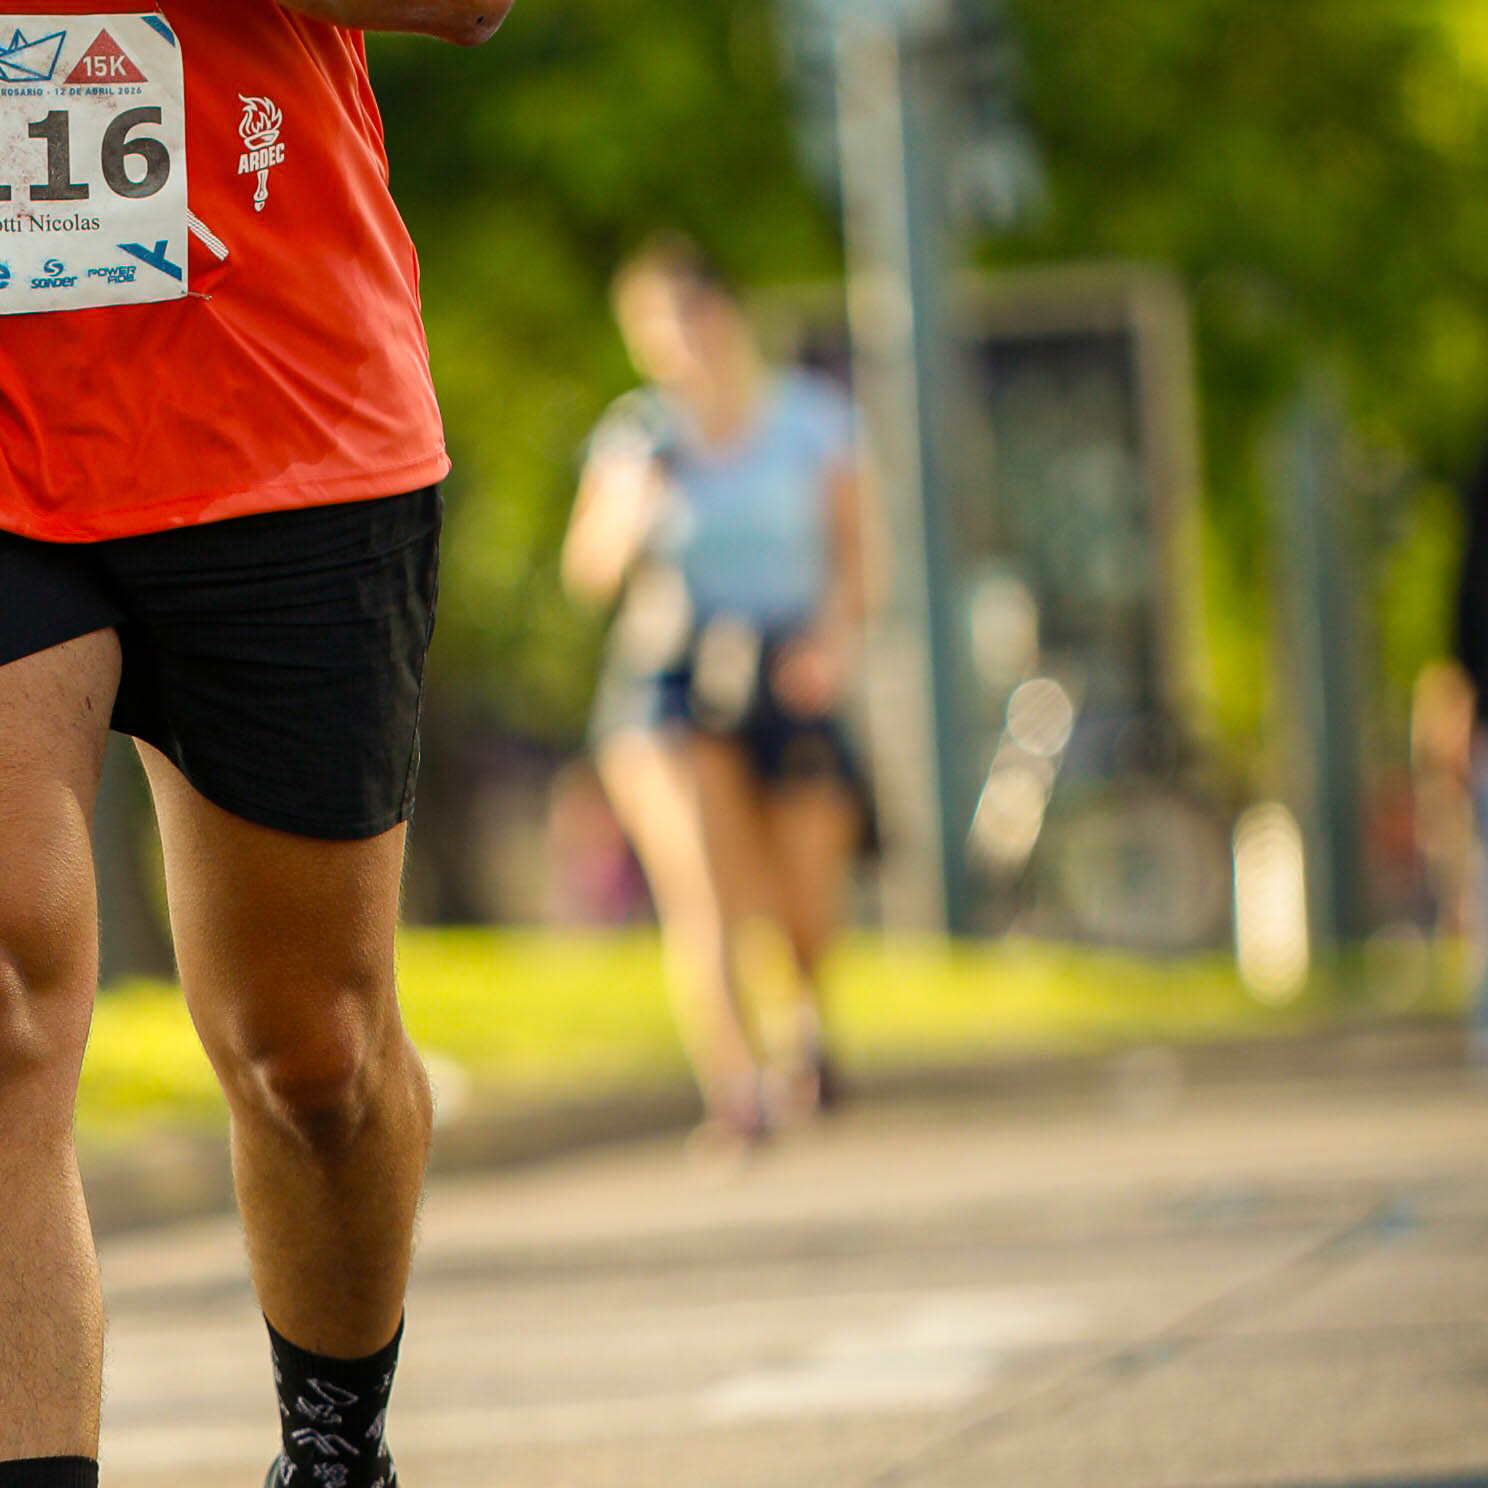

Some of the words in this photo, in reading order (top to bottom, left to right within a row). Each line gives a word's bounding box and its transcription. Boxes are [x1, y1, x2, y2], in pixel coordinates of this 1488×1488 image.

[83, 55, 126, 77] 15K
[1, 87, 44, 97] ROSARIO
[55, 87, 66, 96] 12
[69, 87, 81, 96] DE
[85, 86, 114, 96] ABRIL
[237, 142, 285, 175] ARDEC
[28, 213, 100, 232] Nicolas
[87, 265, 136, 278] POWER
